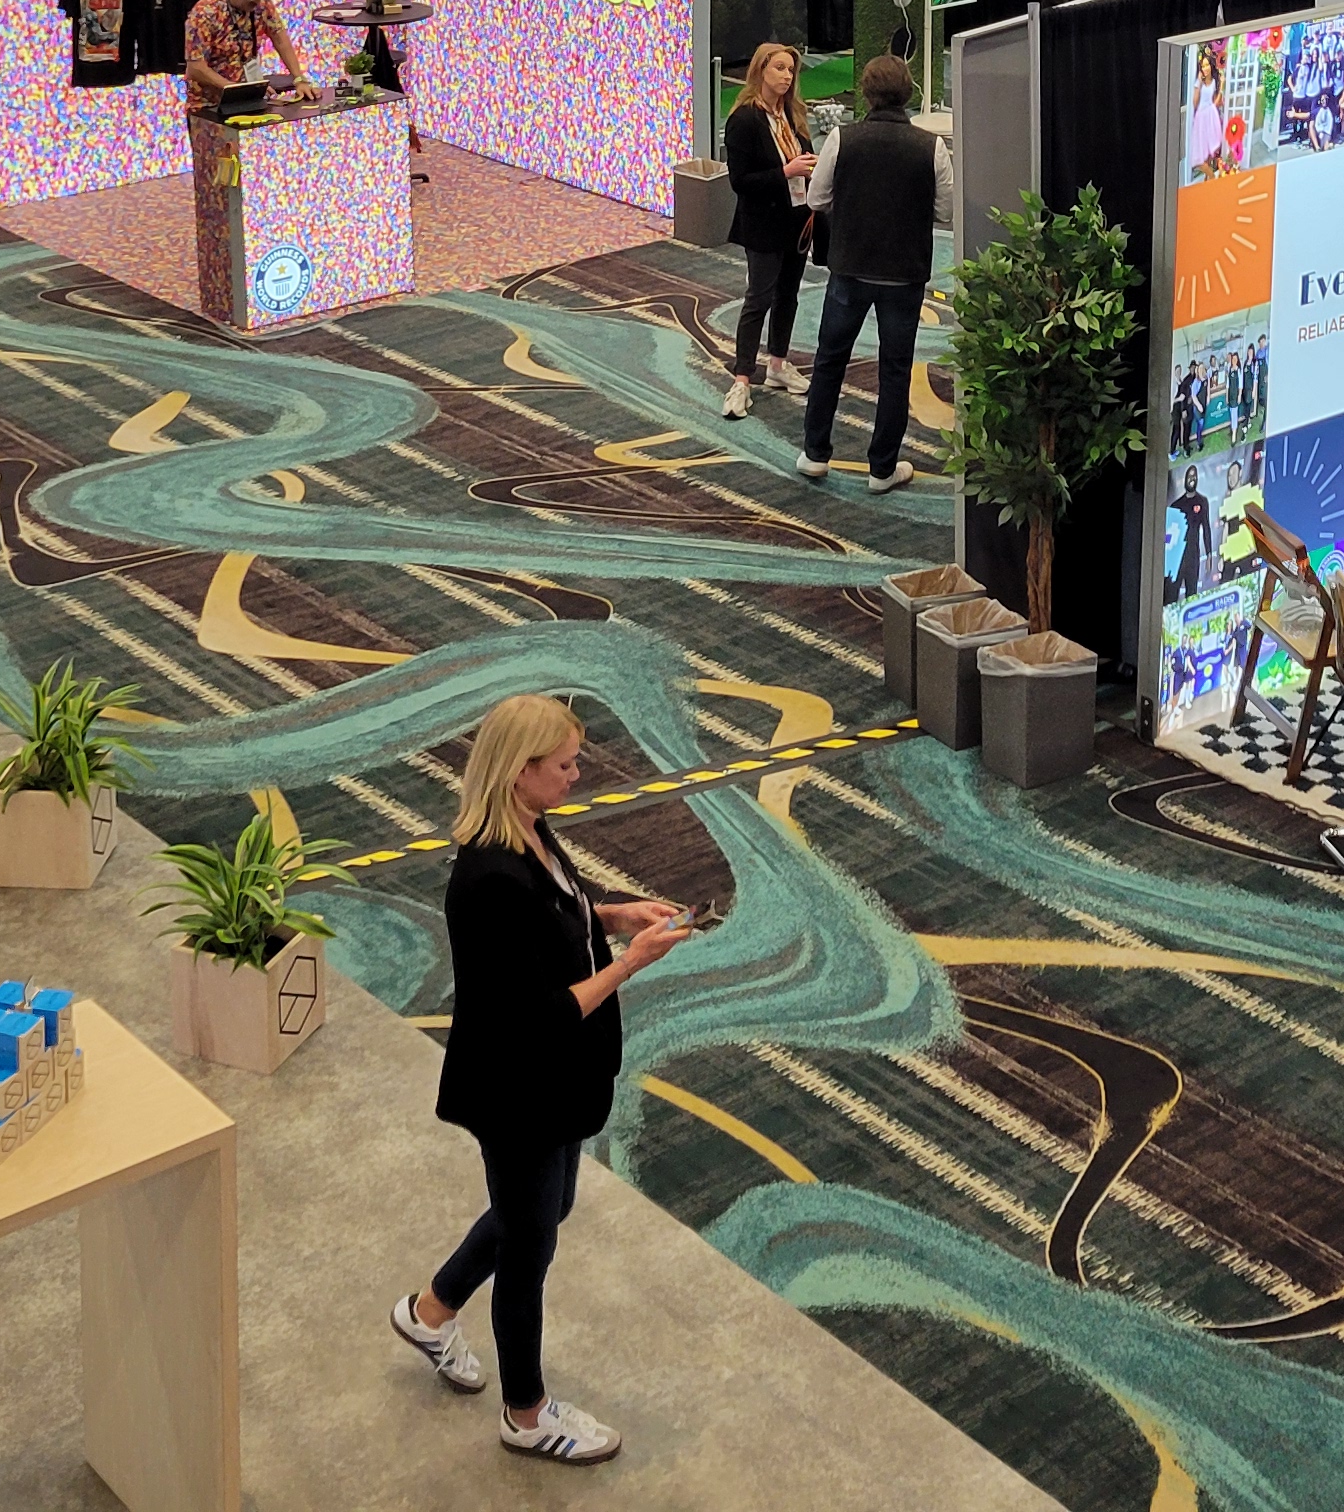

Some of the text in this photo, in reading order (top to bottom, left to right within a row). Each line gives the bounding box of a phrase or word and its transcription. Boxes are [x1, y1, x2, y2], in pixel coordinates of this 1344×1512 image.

[260, 248, 305, 273] GUINNESS
[256, 268, 310, 310] WORLD RECORDS
